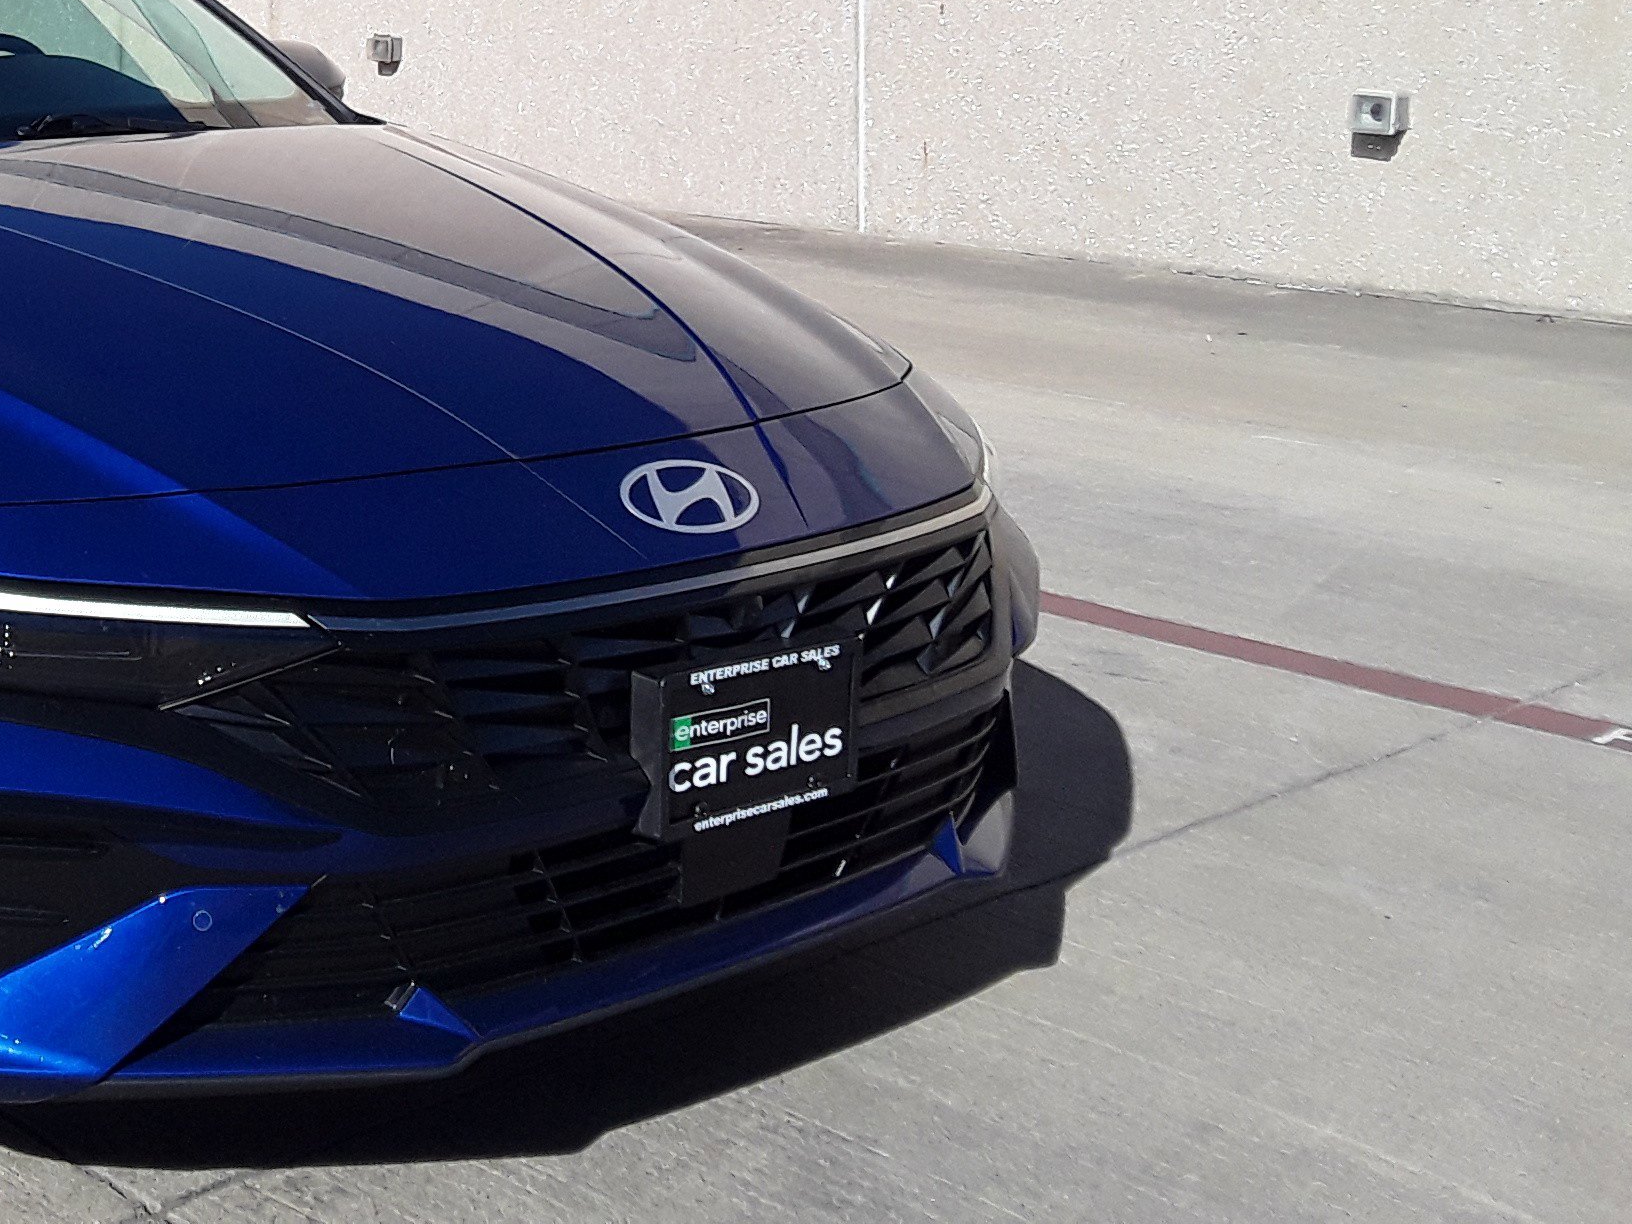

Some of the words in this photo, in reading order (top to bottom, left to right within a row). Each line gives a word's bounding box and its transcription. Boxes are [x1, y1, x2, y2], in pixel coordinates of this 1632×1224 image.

[690, 658, 770, 686] ENTERPRISE
[771, 652, 799, 669] CAR
[800, 644, 841, 663] SALES
[674, 709, 768, 742] enterprise
[668, 751, 737, 793] car
[744, 723, 843, 776] sales
[694, 787, 829, 832] enterprisecarsales.com
